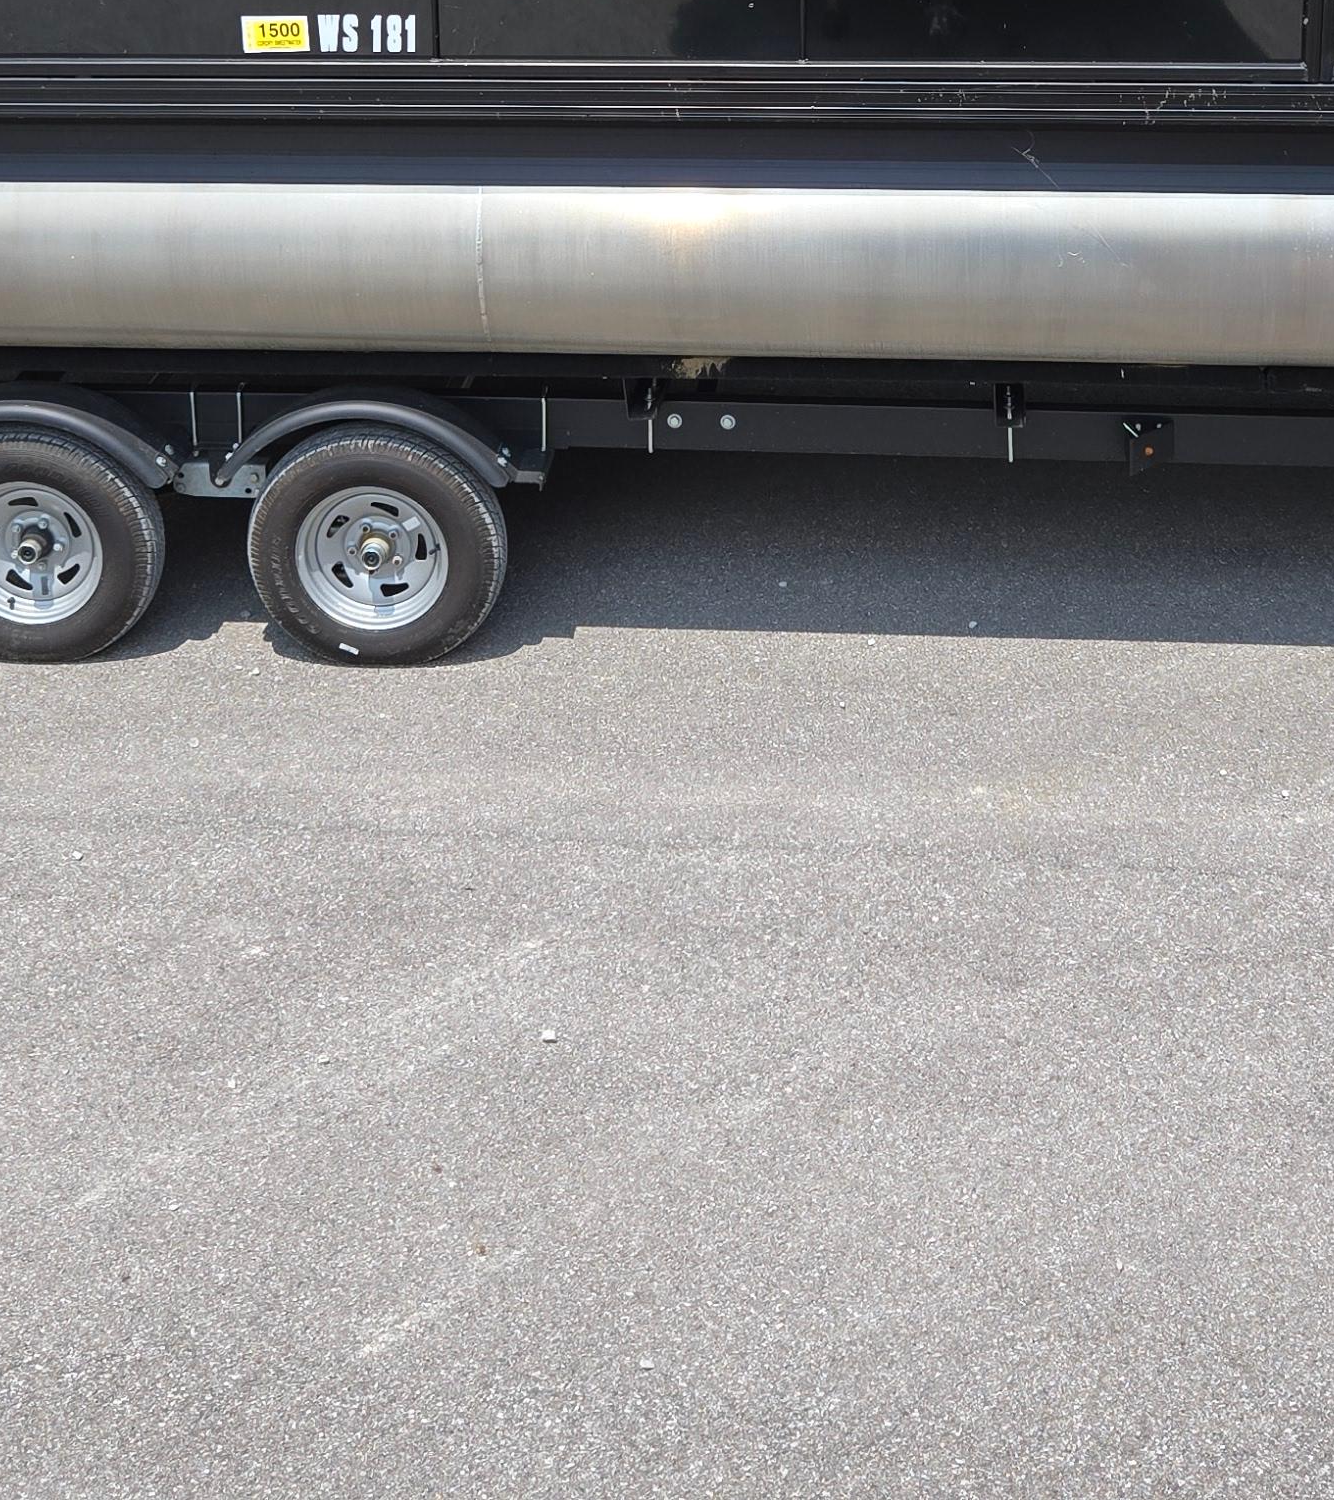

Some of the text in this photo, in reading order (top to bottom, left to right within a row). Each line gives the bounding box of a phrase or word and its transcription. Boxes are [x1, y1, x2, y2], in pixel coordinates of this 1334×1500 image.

[258, 22, 300, 38] 1500
[317, 13, 416, 53] WS 181
